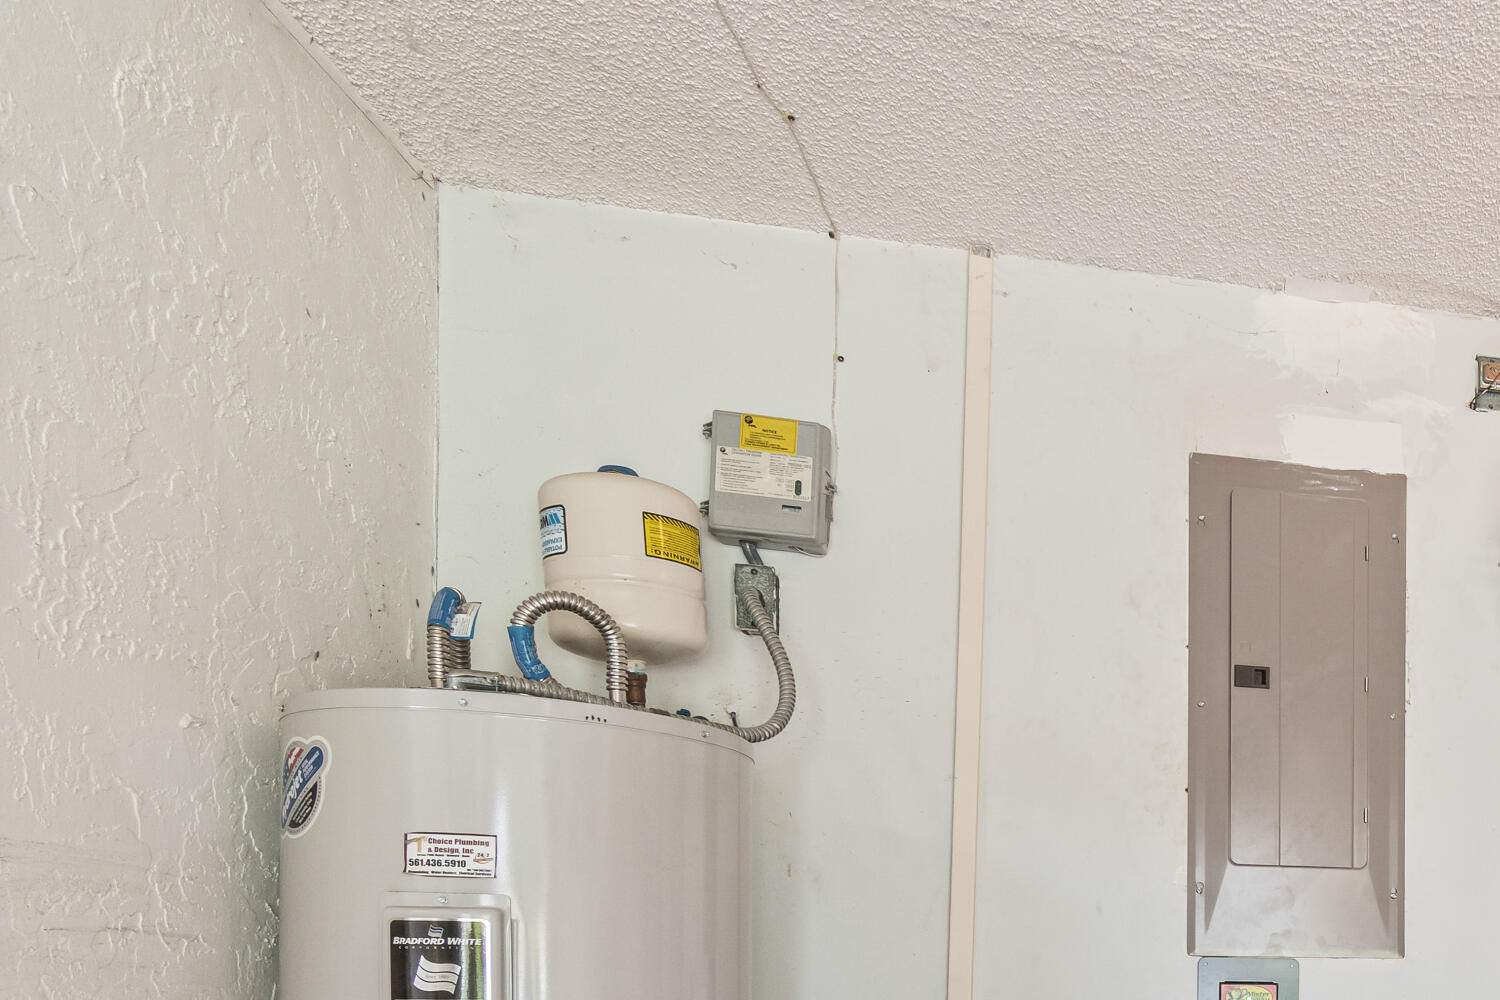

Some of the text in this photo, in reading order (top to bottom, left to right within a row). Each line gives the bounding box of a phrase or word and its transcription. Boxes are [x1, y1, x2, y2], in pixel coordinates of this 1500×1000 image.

[427, 837, 490, 847] Choice Plumbing
[408, 858, 467, 868] 561.436.5910
[447, 937, 482, 946] WHITE
